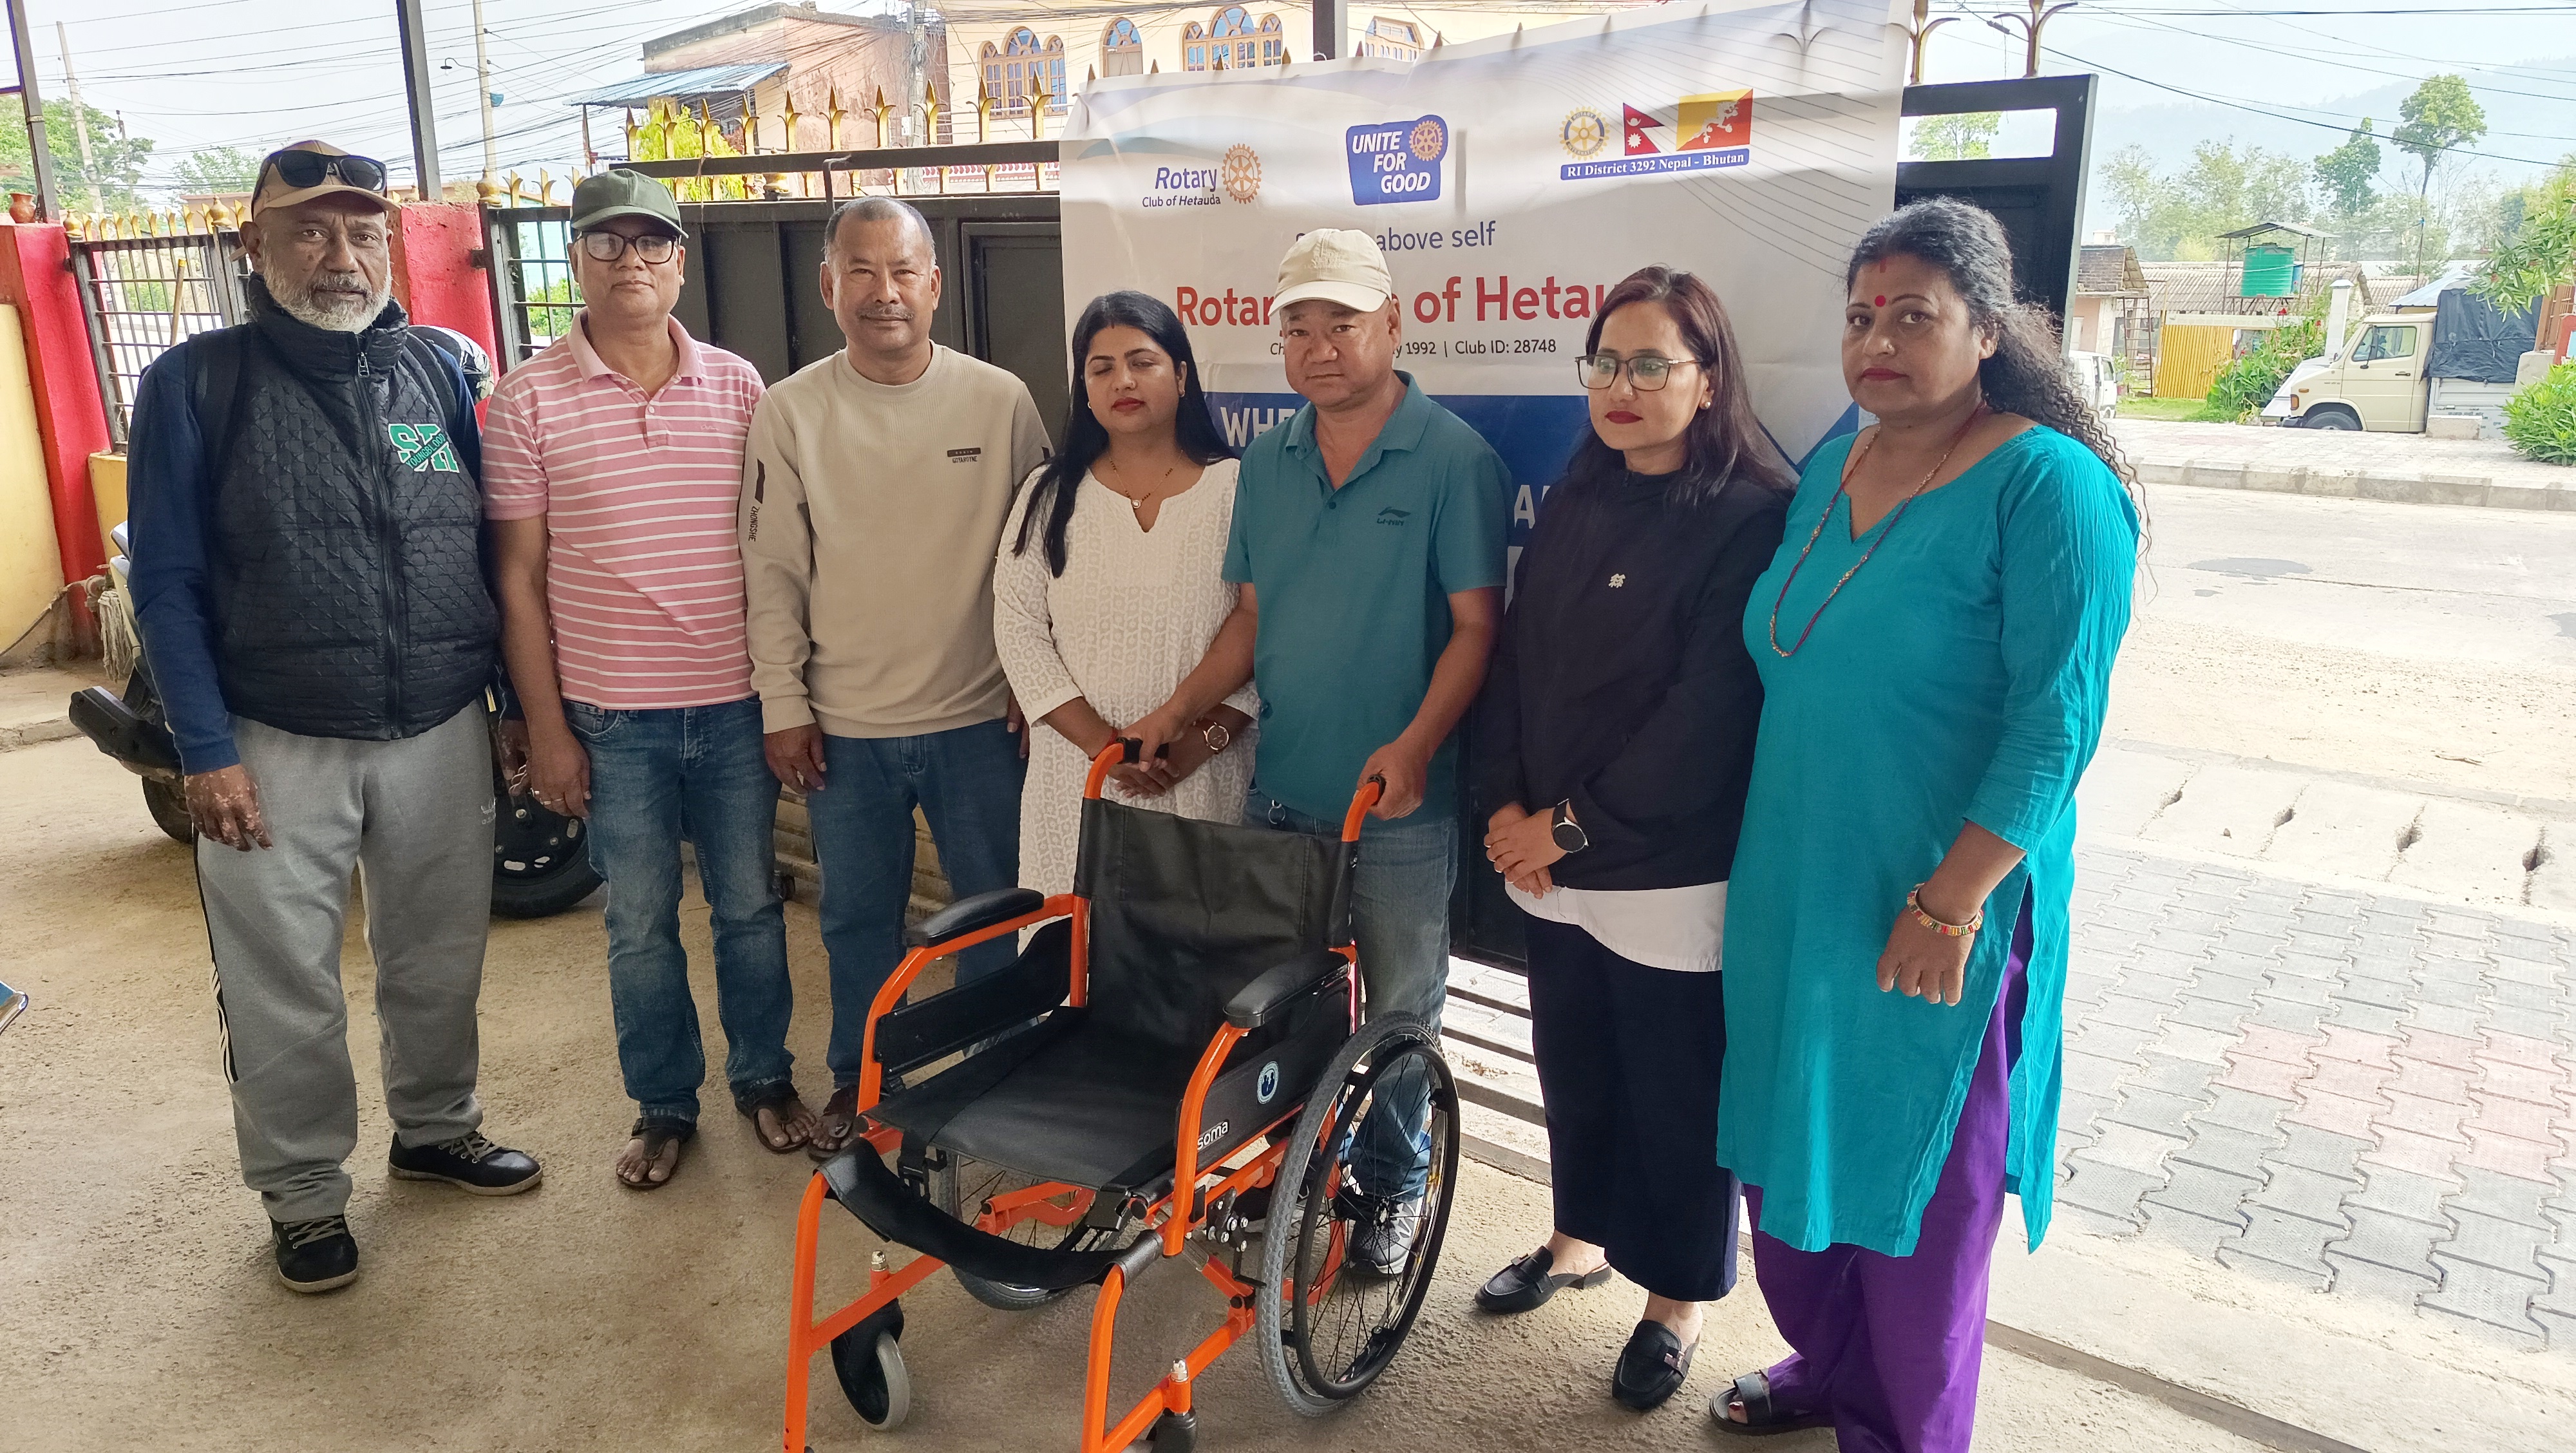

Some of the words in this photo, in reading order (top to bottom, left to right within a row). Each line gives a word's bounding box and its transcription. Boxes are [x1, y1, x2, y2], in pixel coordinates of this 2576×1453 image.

[1352, 131, 1403, 154] UNITE
[1373, 152, 1407, 173] FOR
[1567, 166, 1581, 177] RI
[1585, 162, 1627, 176] District
[1630, 160, 1656, 172] 3292
[1659, 157, 1691, 172] Nepal
[1703, 154, 1745, 166] Bhutan
[1155, 167, 1217, 192] Rotary
[1381, 172, 1430, 193] GOOD
[1142, 196, 1164, 207] Club
[1166, 195, 1177, 207] of
[1179, 194, 1221, 206] Hetauda
[1376, 227, 1443, 251] above
[1452, 220, 1496, 247] self
[1177, 287, 1279, 330] Rotar
[1414, 276, 1461, 323] of
[1406, 341, 1437, 355] 1992
[1455, 340, 1486, 354] Club
[1491, 340, 1510, 354] ID:
[1514, 339, 1557, 354] 28748
[748, 506, 760, 542] ZHONGSHE
[1197, 1121, 1228, 1150] soma
